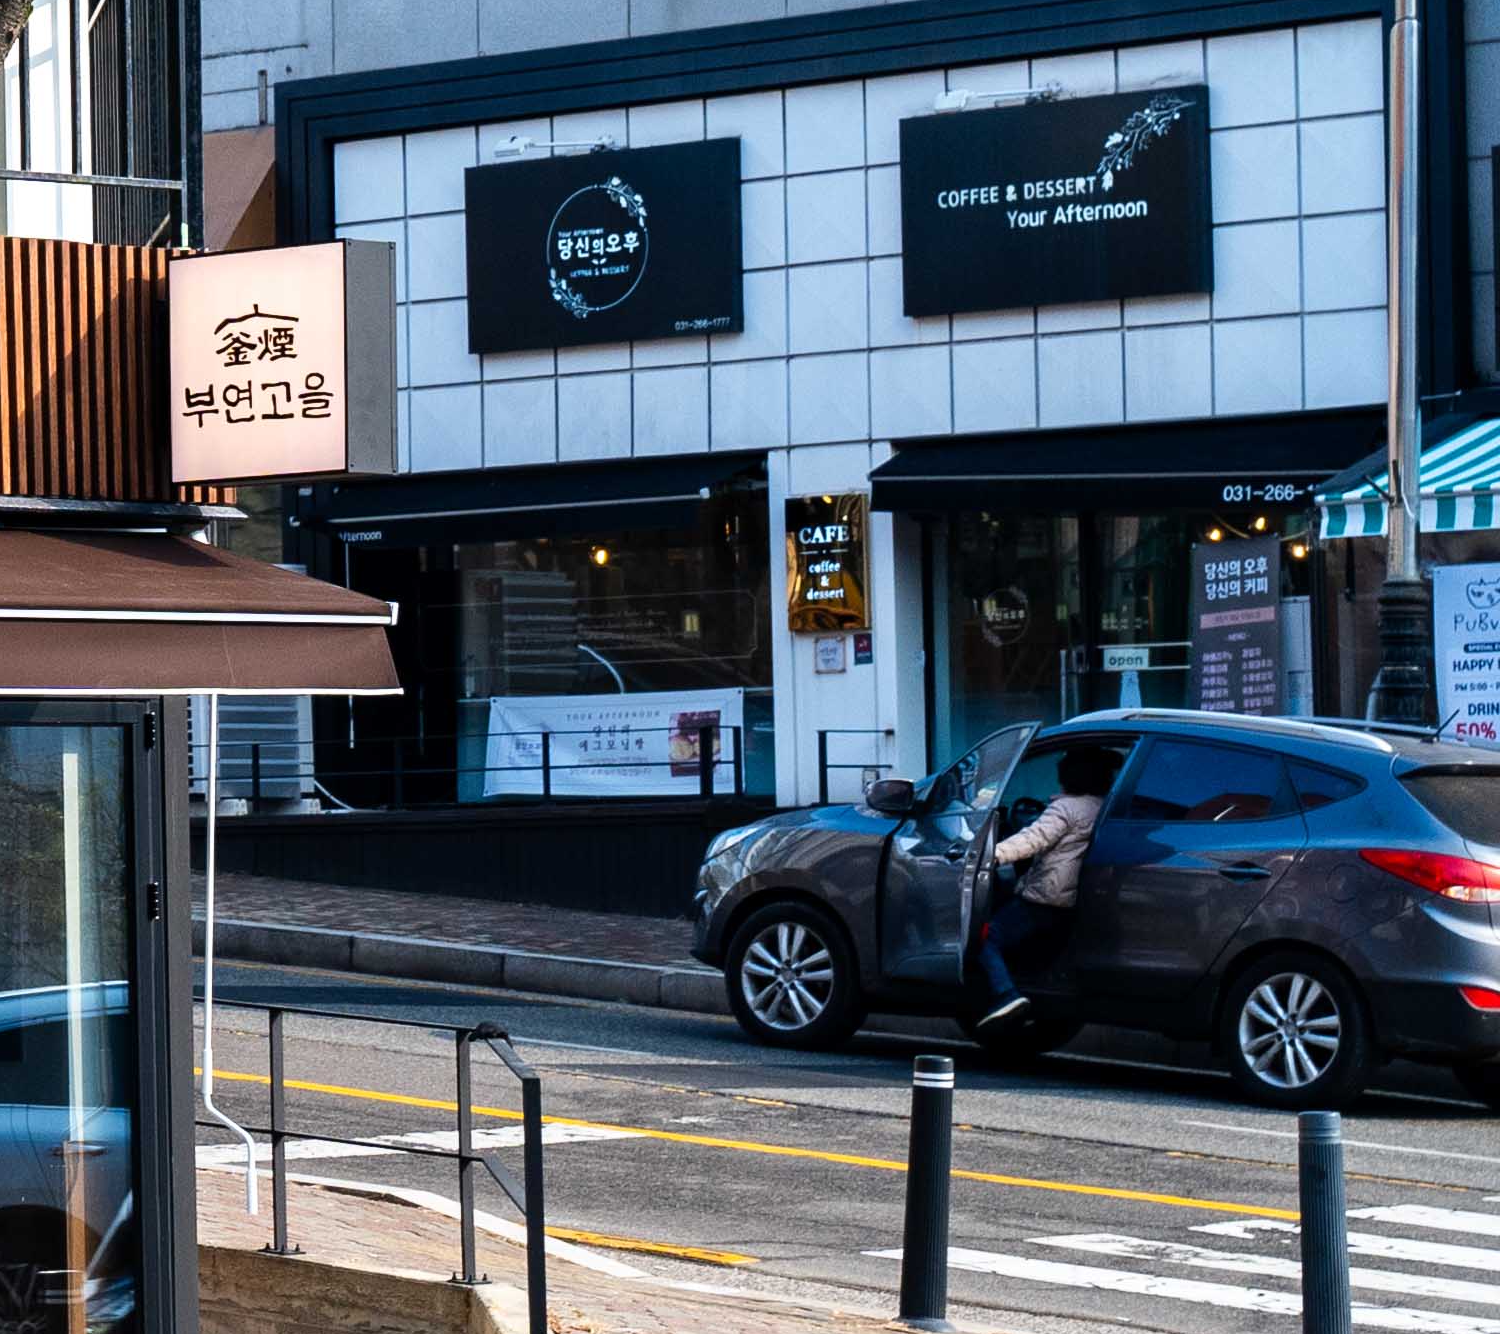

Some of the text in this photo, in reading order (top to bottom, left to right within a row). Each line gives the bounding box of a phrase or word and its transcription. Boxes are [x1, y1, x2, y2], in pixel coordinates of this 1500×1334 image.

[937, 175, 1097, 209] COFFEE & DESSERT
[1006, 199, 1148, 229] Your Afternoon
[558, 231, 640, 260] 당신의오후
[216, 326, 299, 367] 釜煙
[182, 372, 334, 428] 부연고을
[799, 524, 850, 545] CAFE
[808, 559, 841, 574] coffee
[1204, 555, 1269, 581] 당신의 오후
[806, 588, 845, 601] dessert
[1205, 576, 1269, 601] 당신의 커피
[1108, 655, 1143, 667] open
[1452, 658, 1495, 672] HAPPY
